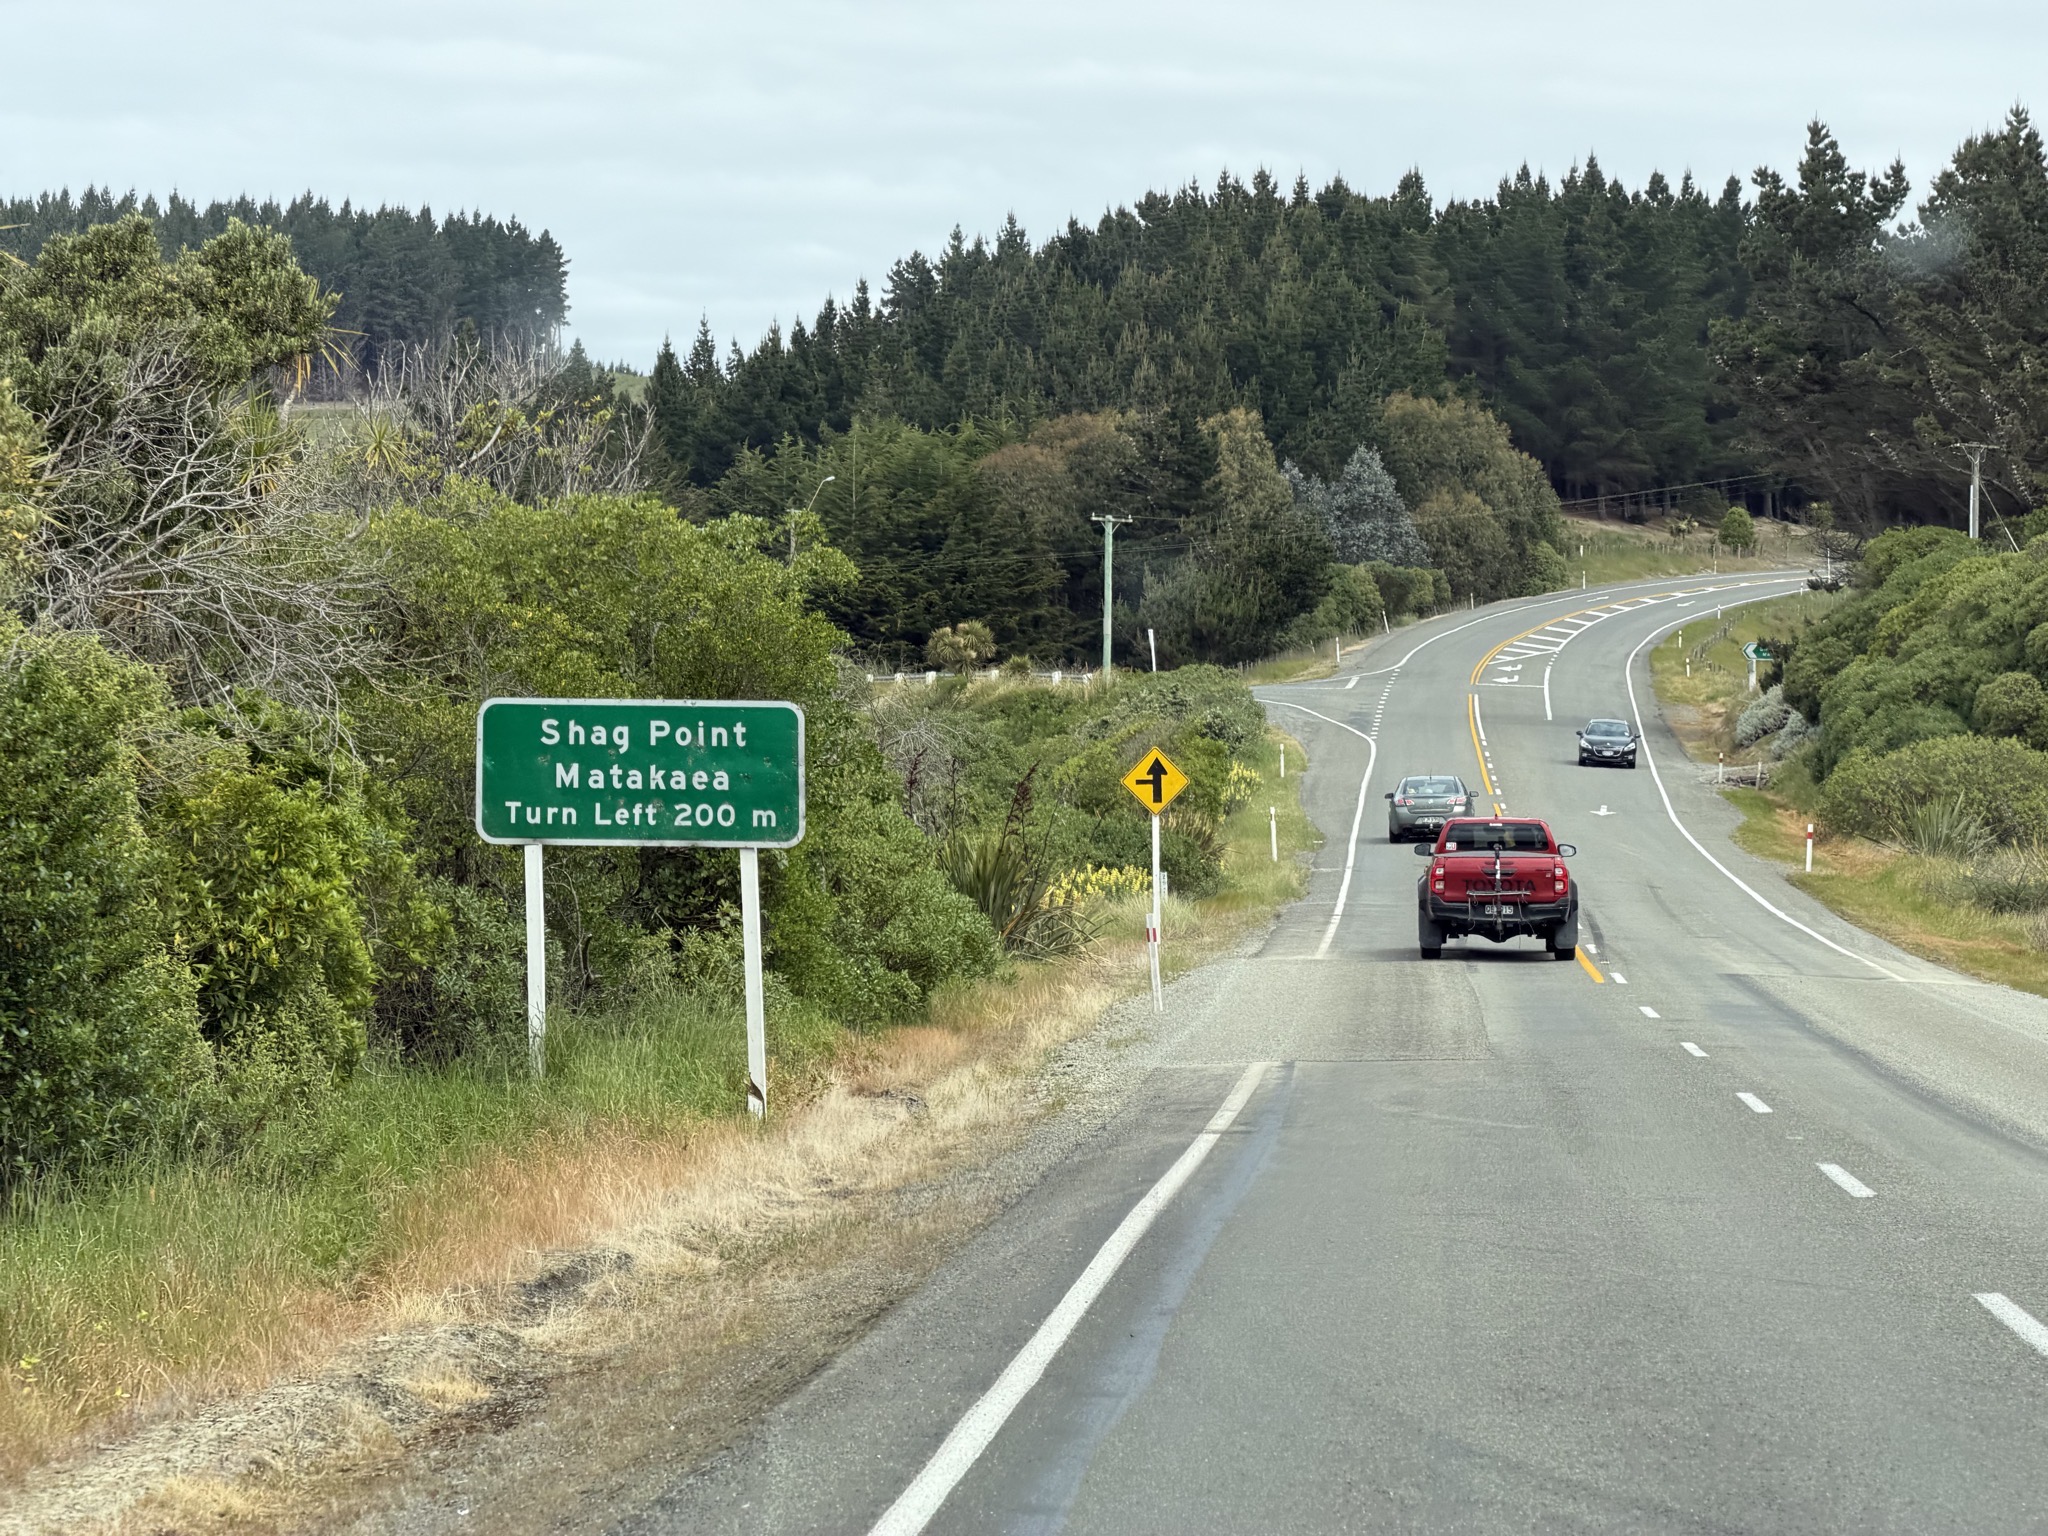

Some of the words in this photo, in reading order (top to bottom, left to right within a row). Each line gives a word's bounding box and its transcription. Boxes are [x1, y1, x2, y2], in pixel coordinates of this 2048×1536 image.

[541, 718, 629, 754] Shag
[650, 720, 746, 747] Point
[556, 762, 729, 790] Matakaea
[505, 801, 577, 825] Turn
[595, 802, 657, 826] Left
[674, 803, 736, 827] 200
[752, 809, 777, 827] m
